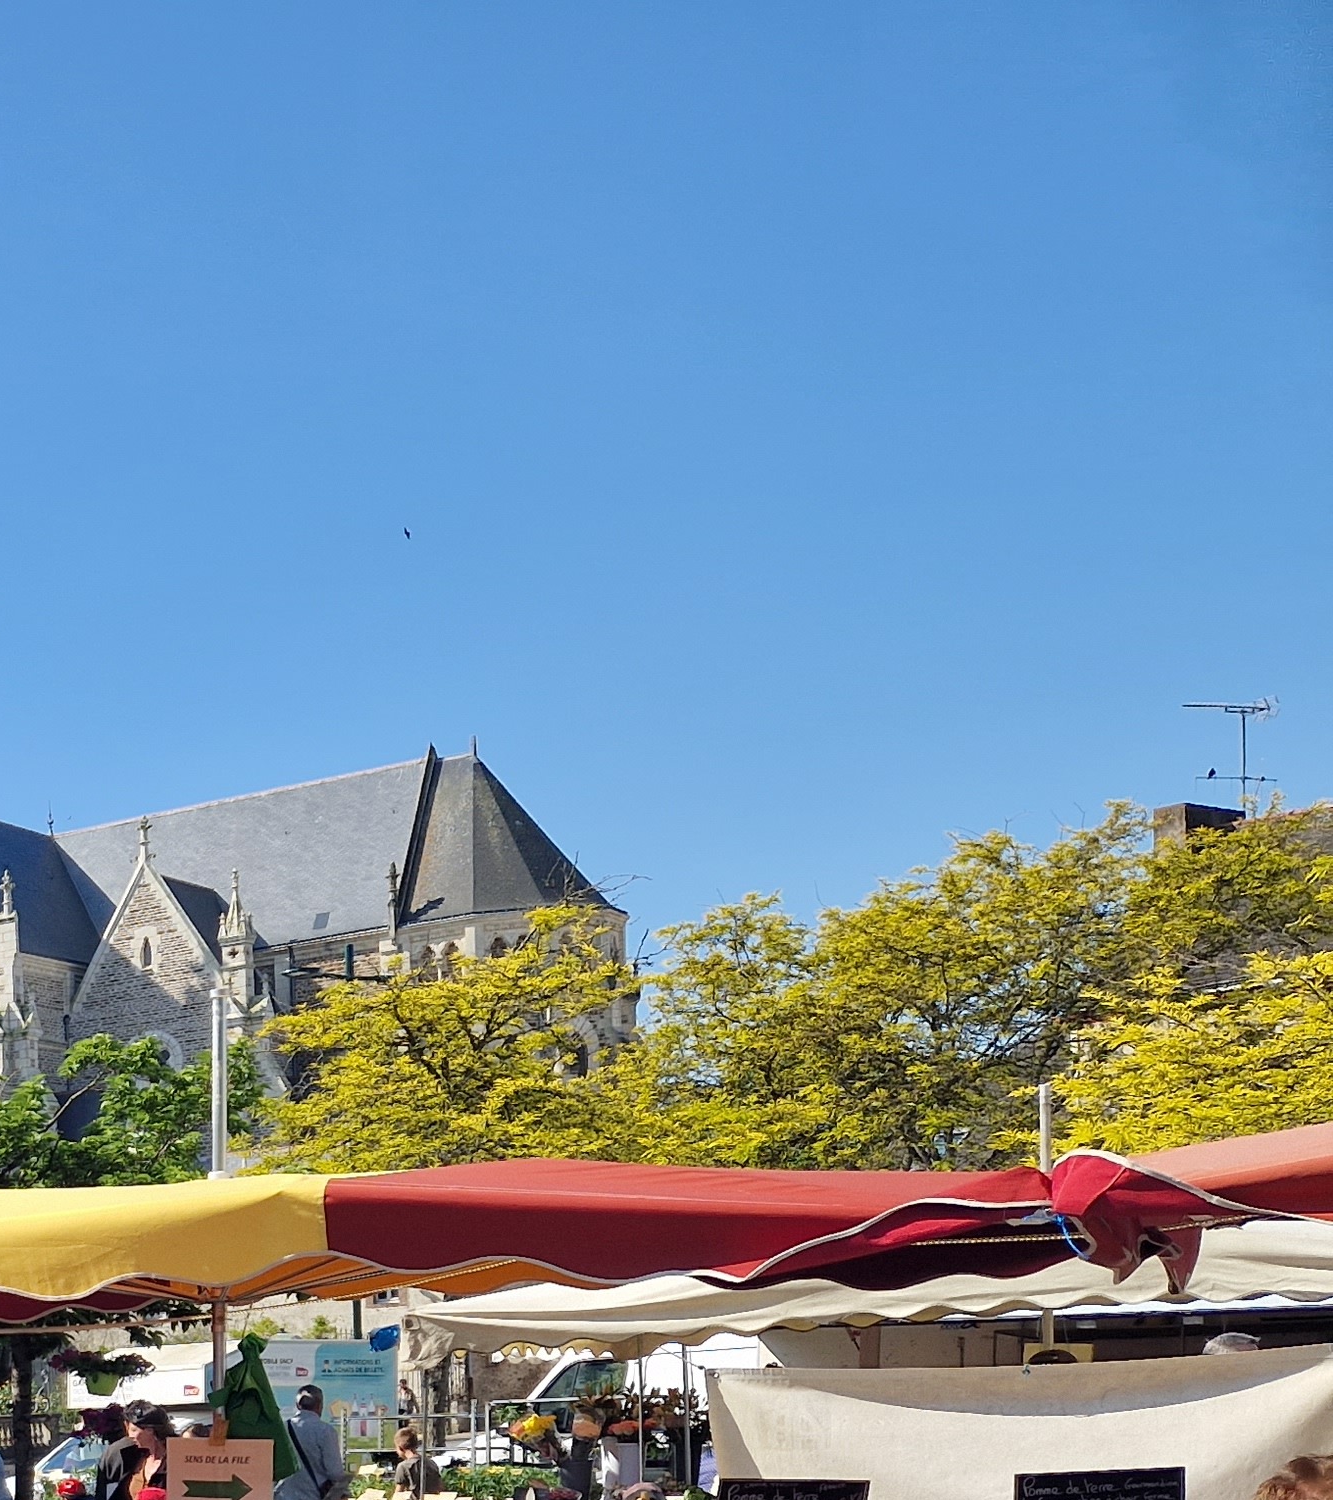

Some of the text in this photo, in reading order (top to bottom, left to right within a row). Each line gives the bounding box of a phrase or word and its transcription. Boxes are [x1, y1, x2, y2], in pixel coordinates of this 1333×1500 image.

[184, 1455, 203, 1463] SENS
[1023, 1476, 1063, 1497] Pomme
[1066, 1479, 1085, 1495] de
[1084, 1478, 1120, 1493] terre
